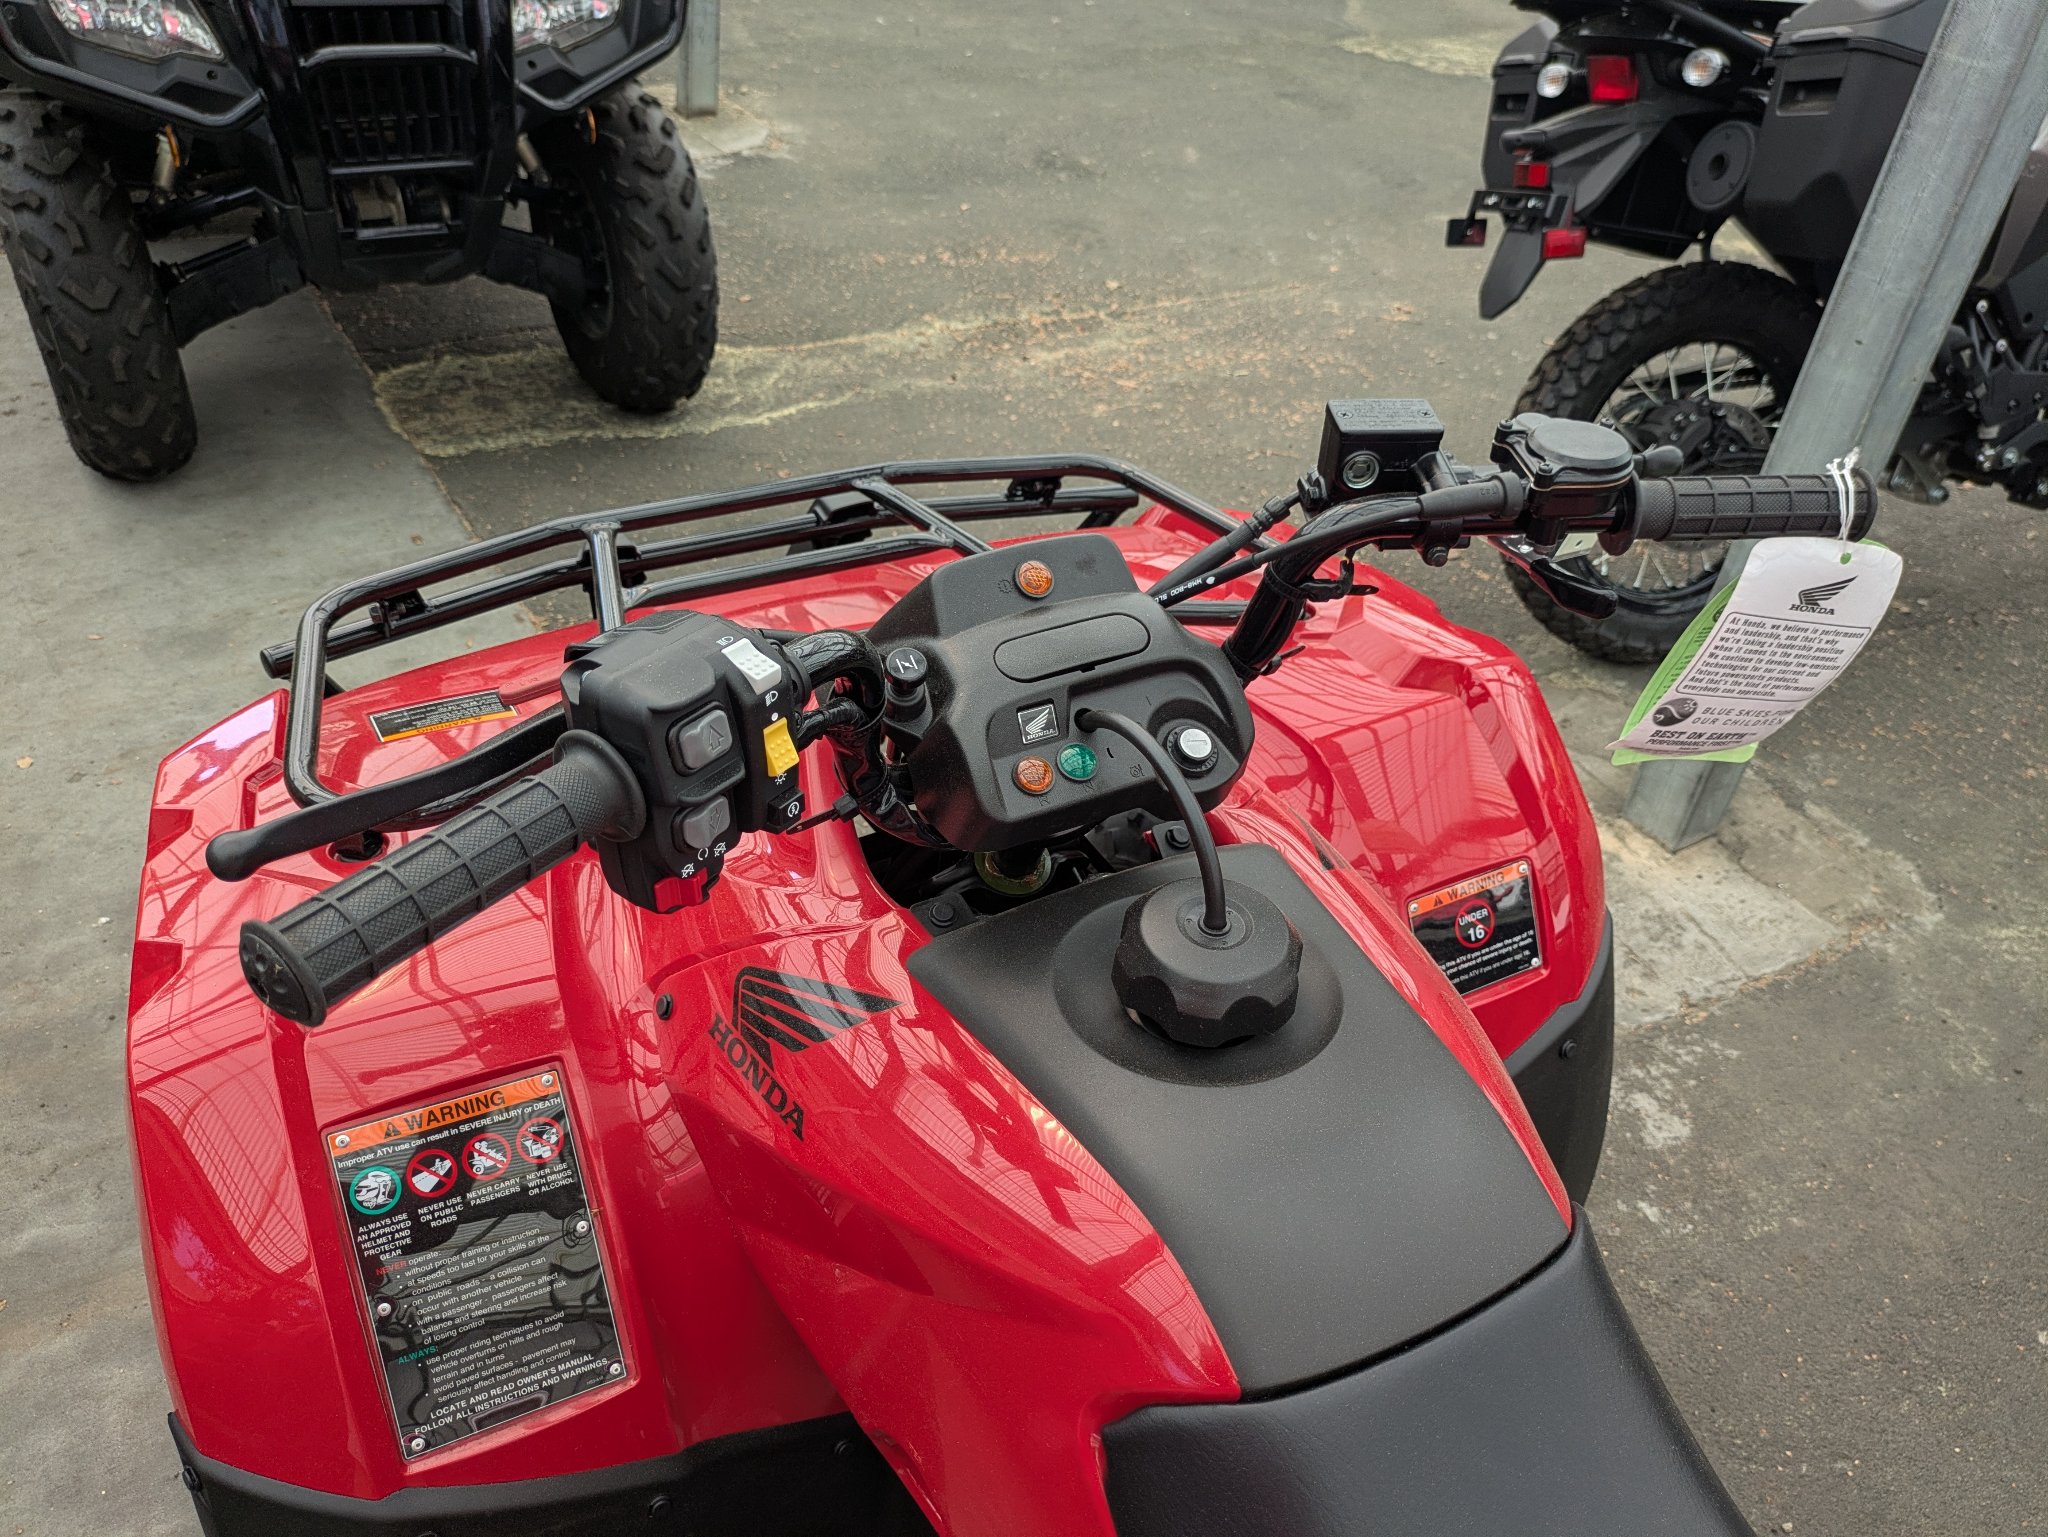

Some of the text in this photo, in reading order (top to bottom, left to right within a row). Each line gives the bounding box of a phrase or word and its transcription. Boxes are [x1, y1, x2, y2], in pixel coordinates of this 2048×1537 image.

[1789, 604, 1835, 615] HONDA
[1723, 626, 1740, 634] and
[1823, 638, 1838, 647] why
[1729, 617, 1741, 625] At
[1783, 624, 1809, 633] believe
[1820, 628, 1862, 640] performance
[1712, 644, 1733, 652] when
[1741, 638, 1766, 647] taking
[1774, 641, 1813, 652] leadership
[1814, 646, 1843, 655] position
[1702, 707, 1734, 716] BLUE
[1738, 709, 1768, 718] SKIES
[1722, 717, 1785, 726] CHILDREN
[1650, 730, 1685, 738] BEST
[1686, 731, 1707, 739] ON
[1447, 872, 1505, 900] WARNING
[1459, 908, 1489, 926] UNDER
[1468, 925, 1485, 942] 16
[707, 1013, 804, 1142] HONDA
[404, 1089, 505, 1132] WARNING
[338, 1151, 374, 1169] Improper
[375, 1146, 393, 1156] ATV
[394, 1142, 409, 1151] use
[410, 1137, 425, 1146] can
[426, 1129, 449, 1141] result
[450, 1126, 458, 1134] in
[458, 1116, 492, 1131] SEVERE
[493, 1107, 522, 1121] INJURY
[533, 1096, 560, 1109] DEATH
[526, 1162, 567, 1180] NEVER USE
[527, 1169, 572, 1188] WITH DRUGS
[465, 1176, 520, 1199] NEVER CARRY
[470, 1185, 520, 1206] PASSENGERS
[528, 1176, 574, 1196] OR ALCOHOL
[417, 1195, 462, 1215] NEVER USE
[420, 1203, 463, 1223] ON PUBLIC
[356, 1219, 412, 1242] AN APPROVED
[358, 1212, 408, 1233] ALWAYS USE
[430, 1214, 457, 1228] ROADS
[361, 1228, 411, 1250] HELMET AND
[363, 1236, 411, 1257] PROTECTIVE
[375, 1249, 441, 1275] NEVER operate:
[379, 1248, 401, 1261] GEAR
[404, 1262, 433, 1276] without
[434, 1254, 459, 1268] proper
[461, 1243, 490, 1259] training
[501, 1227, 539, 1244] instruction
[407, 1278, 415, 1286] at
[416, 1268, 445, 1284] speeds
[446, 1263, 459, 1273] too
[460, 1258, 475, 1268] fast
[477, 1254, 487, 1263] for
[489, 1249, 506, 1260] your
[507, 1241, 526, 1252] skills
[537, 1233, 549, 1243] the
[411, 1276, 451, 1296] conditions
[412, 1298, 423, 1306] on
[427, 1287, 452, 1302] public
[456, 1277, 480, 1291] roads
[496, 1261, 529, 1277] collision
[530, 1256, 545, 1265] can
[416, 1274, 522, 1315] occur with another vehicle
[416, 1314, 432, 1326] with
[441, 1298, 483, 1318] passenger
[491, 1280, 536, 1301] passengers
[537, 1271, 558, 1284] affect
[421, 1278, 566, 1334] balance and steering and increase risk
[423, 1317, 485, 1344] of losing control
[426, 1310, 564, 1365] use proper riding techniques to avoid
[397, 1344, 438, 1365] ALWAYS:
[430, 1320, 563, 1374] vehicle overturns on hills and rough
[432, 1352, 505, 1384] terrain and in turns
[433, 1337, 576, 1394] avoid paved surfaces pavement may
[437, 1348, 570, 1404] seriously affect handling and control
[414, 1356, 609, 1435] FOLLOW ALL INSTRUCTIONS AND WARNINGS.
[430, 1352, 593, 1419] LOCATE AND READ OWNER'S MANUAL
